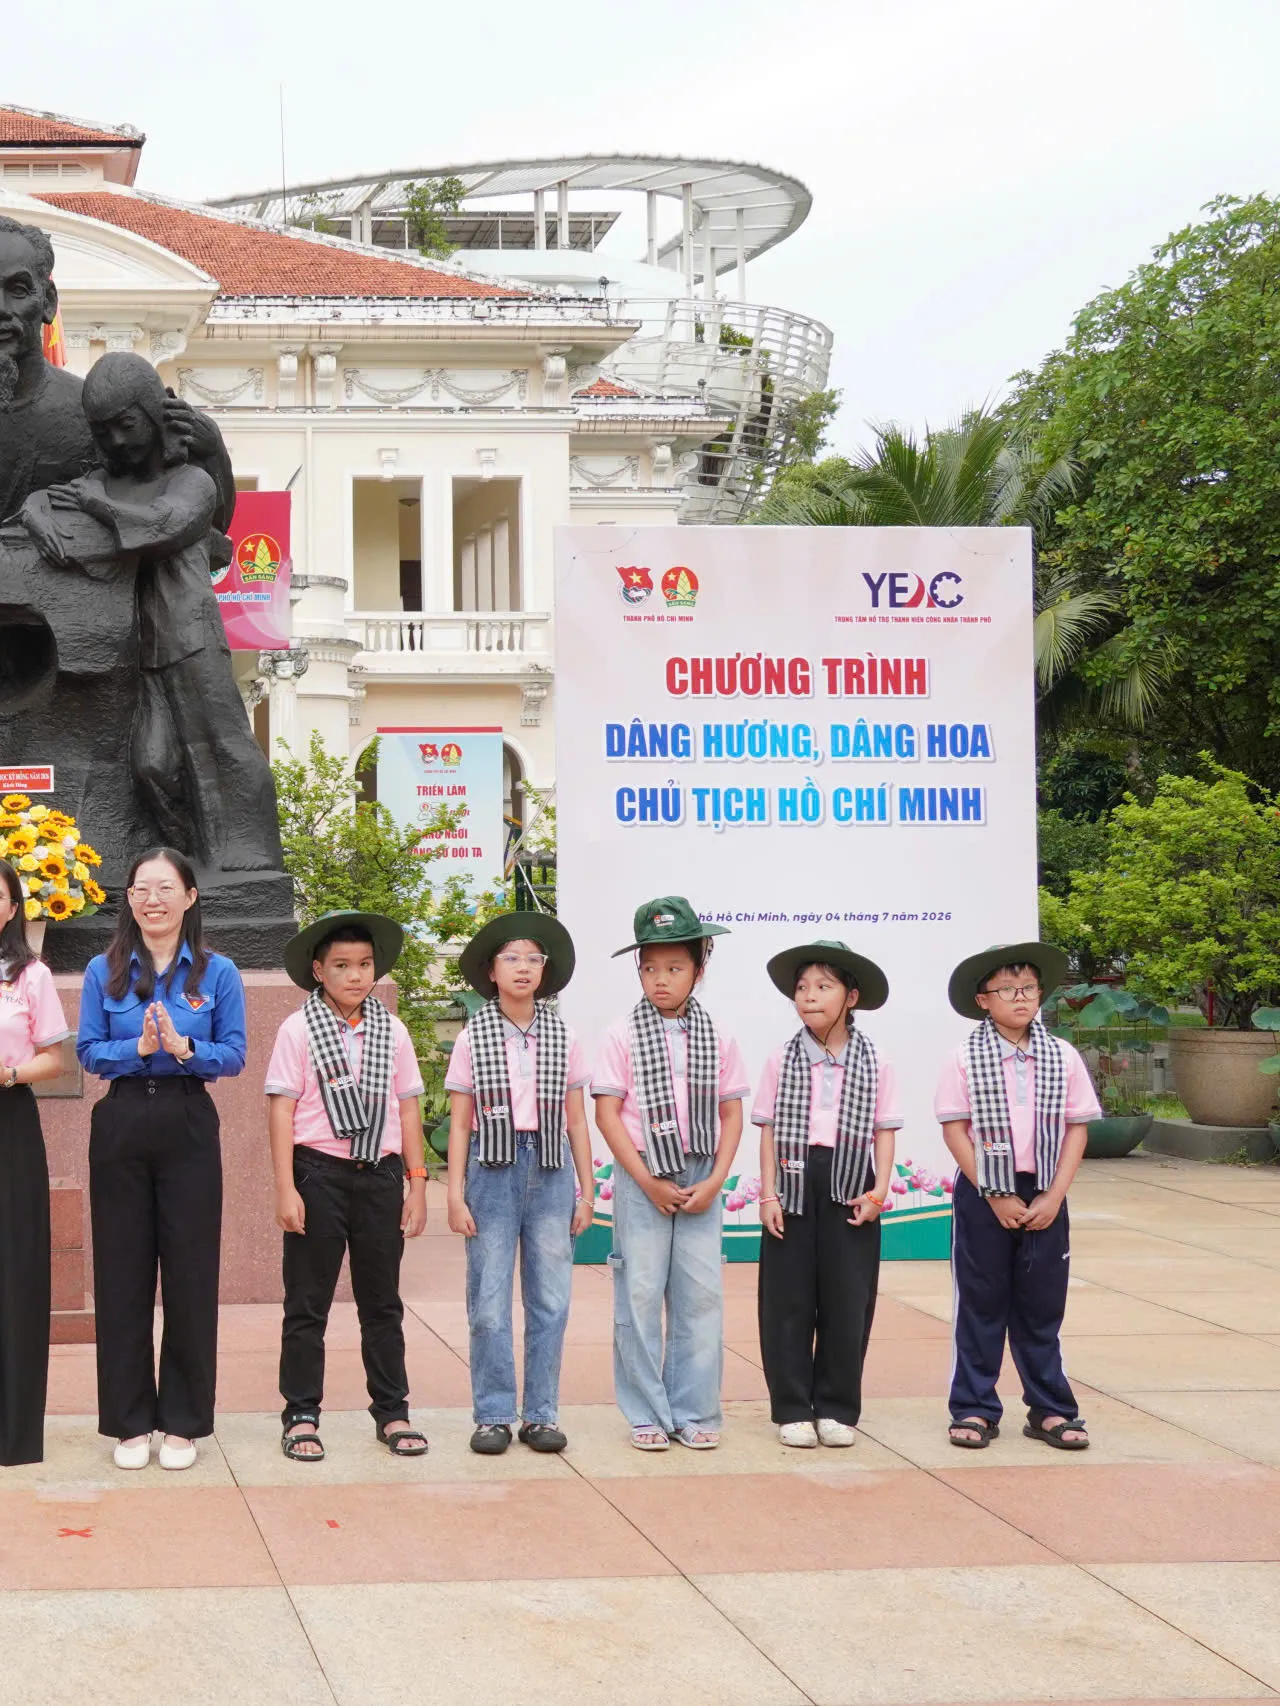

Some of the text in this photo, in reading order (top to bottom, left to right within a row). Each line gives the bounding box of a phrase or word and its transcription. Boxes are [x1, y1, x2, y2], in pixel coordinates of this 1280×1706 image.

[665, 651, 928, 696] CHƯƠNG TRÌNH
[605, 717, 991, 762] DÂNG HƯƠNG, DÂNG HOA
[614, 776, 982, 829] CHỦ TỊCH HỒ CHÍ MINH
[471, 847, 483, 858] TA
[698, 910, 953, 924] hố Hồ Chí Minh, ngày 04 tháng 7 năm 2026
